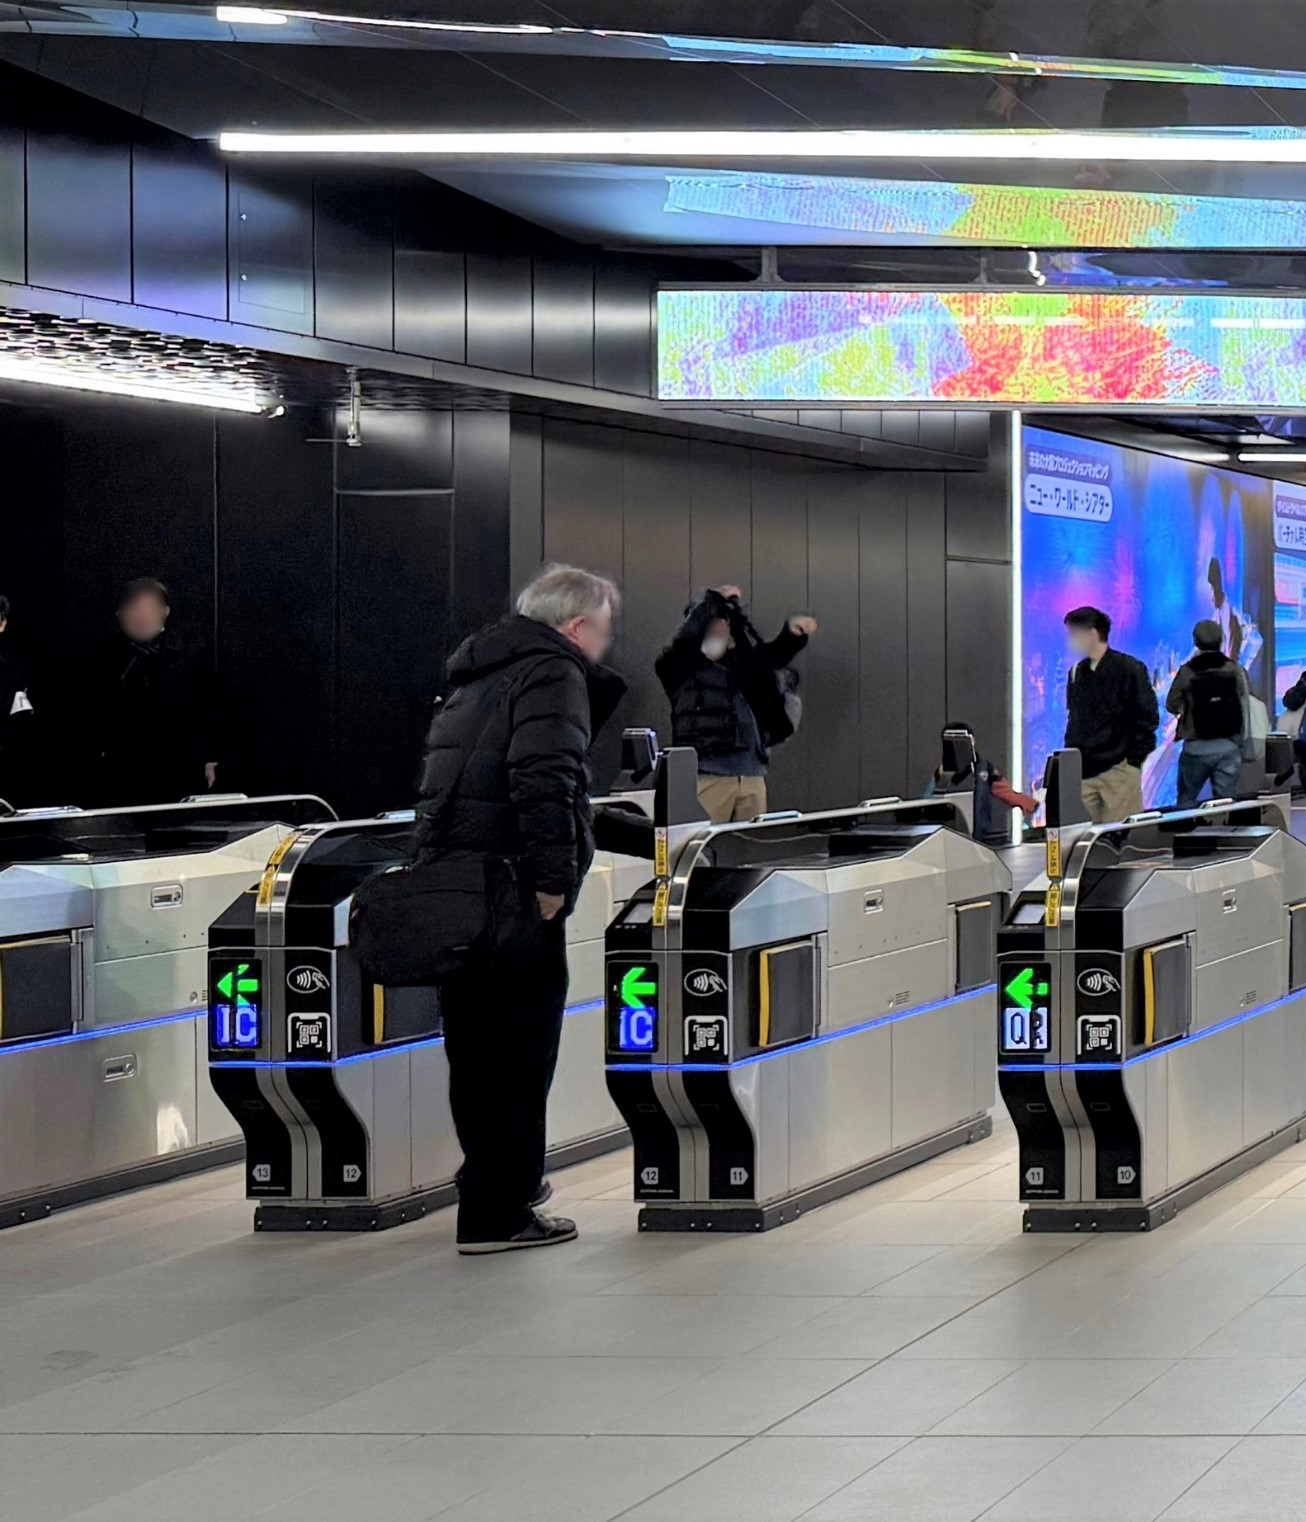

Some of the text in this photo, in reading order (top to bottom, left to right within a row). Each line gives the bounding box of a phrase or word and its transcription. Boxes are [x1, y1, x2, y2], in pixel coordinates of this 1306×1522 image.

[222, 1004, 257, 1043] IC
[620, 1009, 653, 1046] IC
[257, 1167, 269, 1178] 13
[346, 1167, 358, 1179] 12
[645, 1170, 657, 1182] 12
[733, 1171, 743, 1182] 11
[1030, 1171, 1041, 1181] 11
[1120, 1169, 1132, 1181] 10
